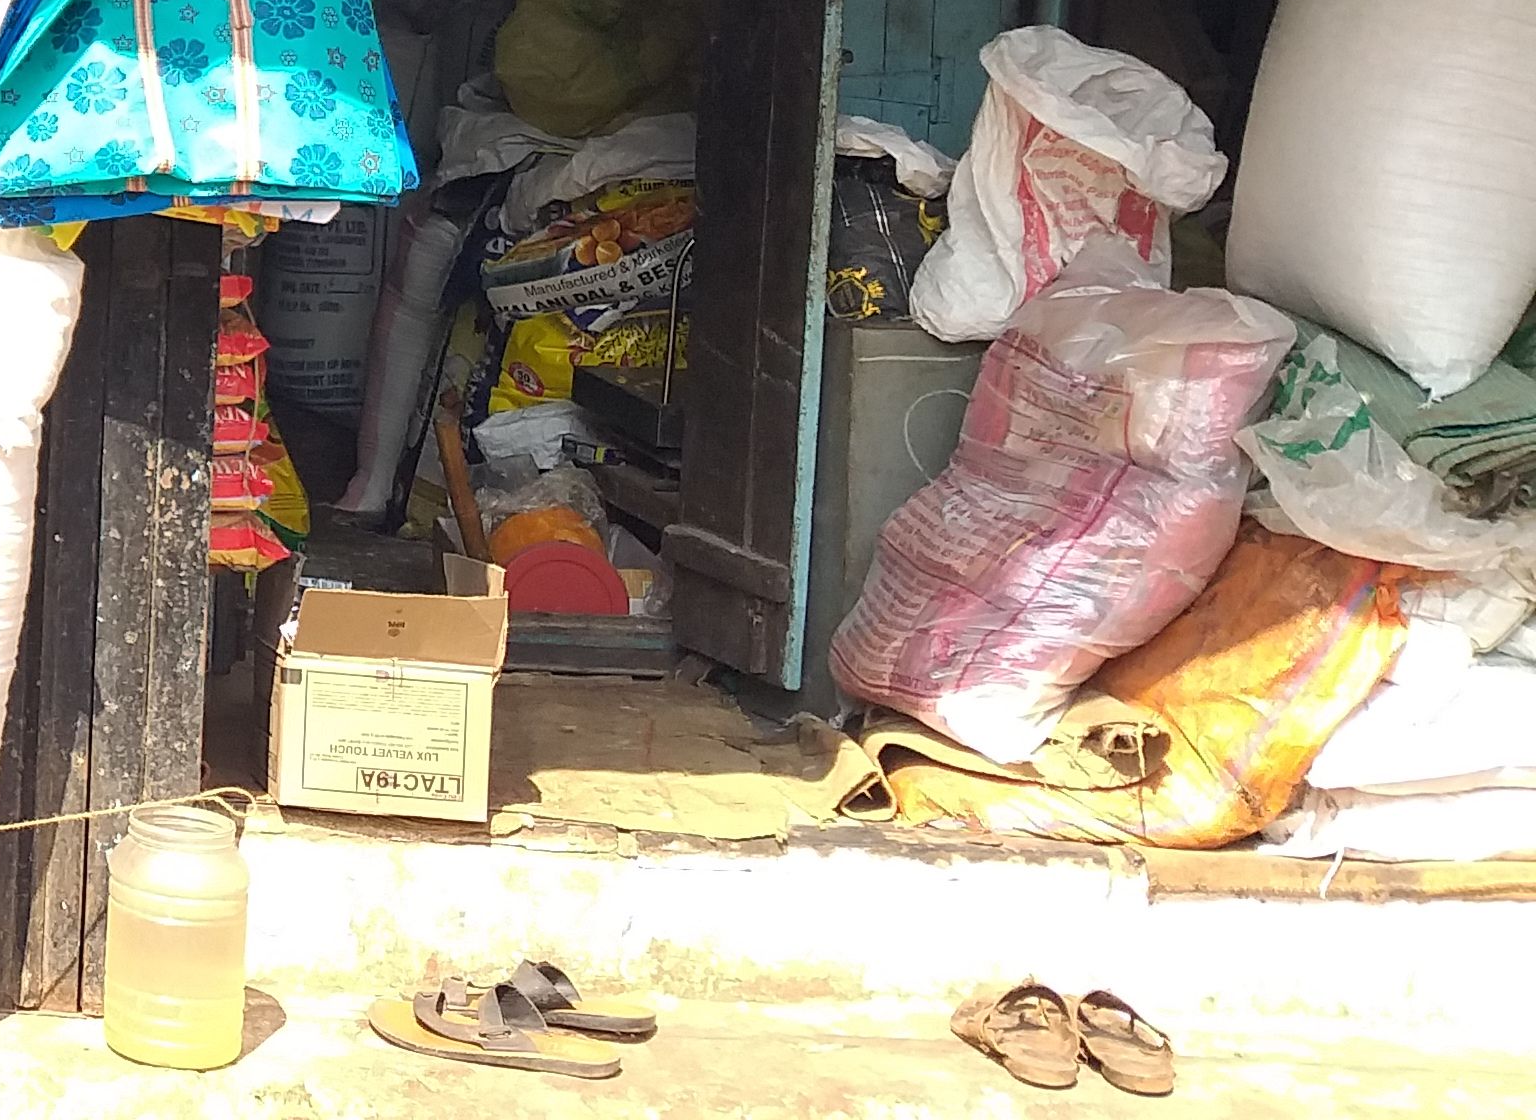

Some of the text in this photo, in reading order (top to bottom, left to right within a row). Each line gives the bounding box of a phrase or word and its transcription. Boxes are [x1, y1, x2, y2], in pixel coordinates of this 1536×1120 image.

[523, 265, 617, 298] Manufactured
[620, 260, 632, 273] &
[572, 286, 614, 306] DAL
[618, 280, 635, 294] &
[329, 744, 439, 762] LUX VELVET TOUCH
[360, 769, 461, 795] LTAC19A
